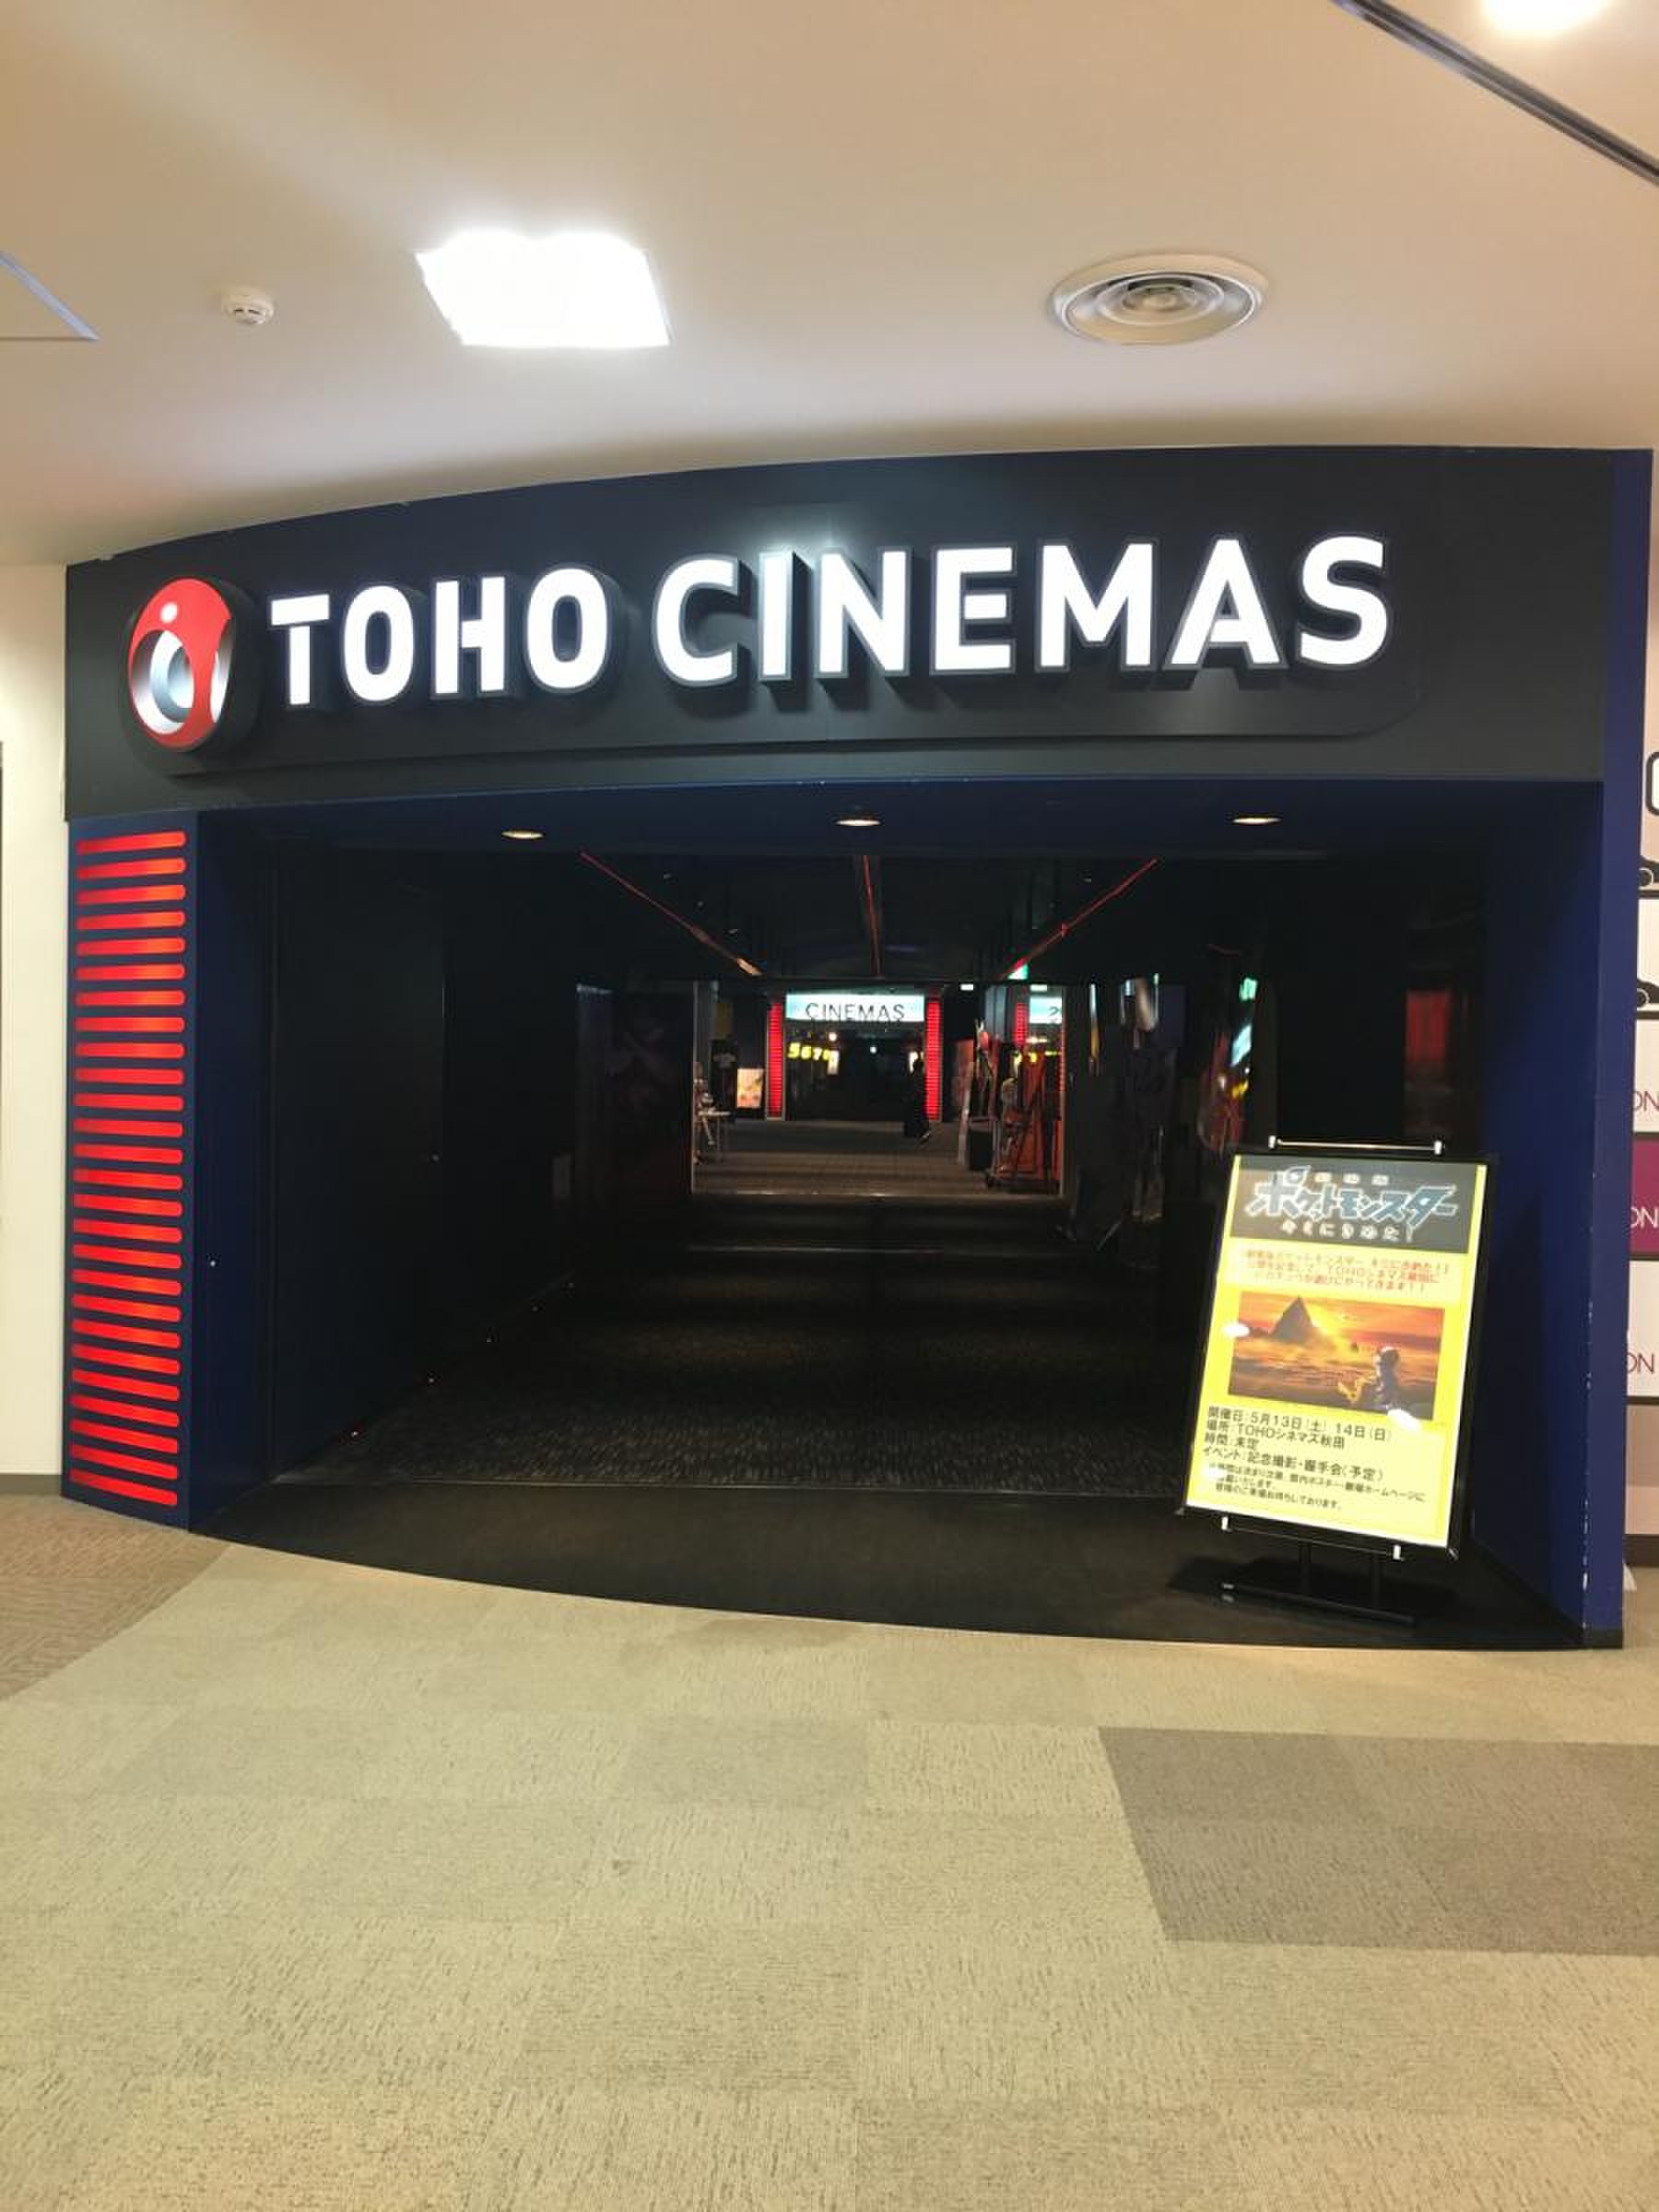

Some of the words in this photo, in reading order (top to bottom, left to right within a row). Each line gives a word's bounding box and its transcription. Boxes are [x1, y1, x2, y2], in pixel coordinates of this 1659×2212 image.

[268, 566, 612, 708] TOHO
[652, 533, 1393, 687] CINEMAS
[805, 1002, 906, 1022] CINEMAS
[1245, 1165, 1458, 1229] ポケットモンスター
